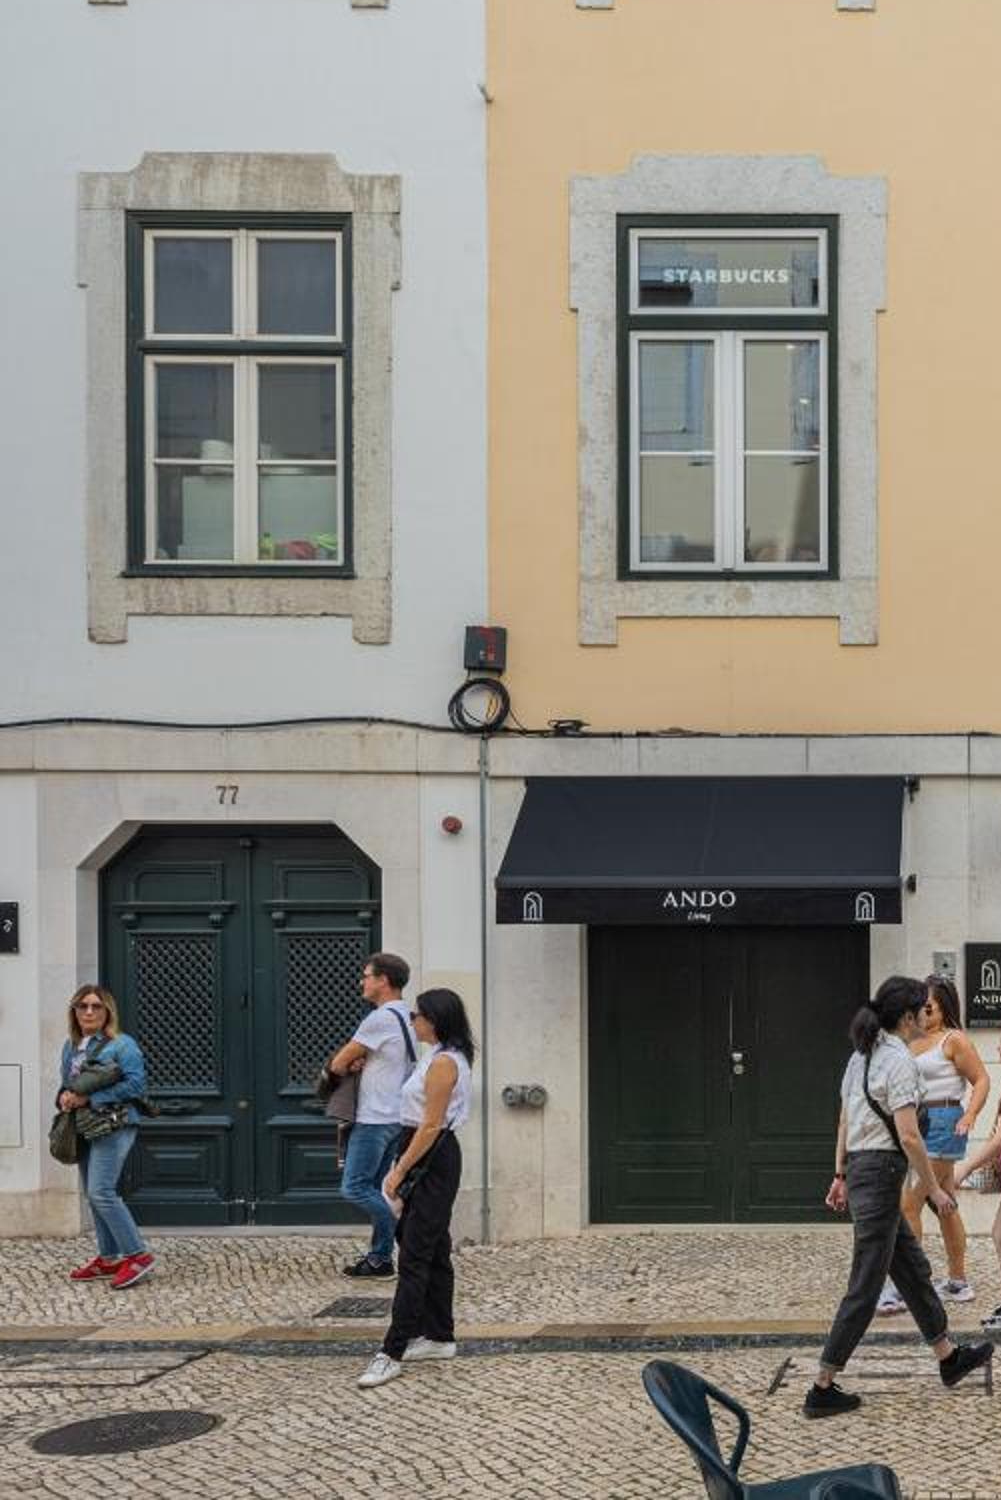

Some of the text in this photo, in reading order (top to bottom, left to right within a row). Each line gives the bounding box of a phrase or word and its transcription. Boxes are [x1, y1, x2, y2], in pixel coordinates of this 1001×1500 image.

[662, 267, 789, 284] STARBUCKS
[215, 785, 239, 805] 77
[662, 889, 737, 908] ANDO
